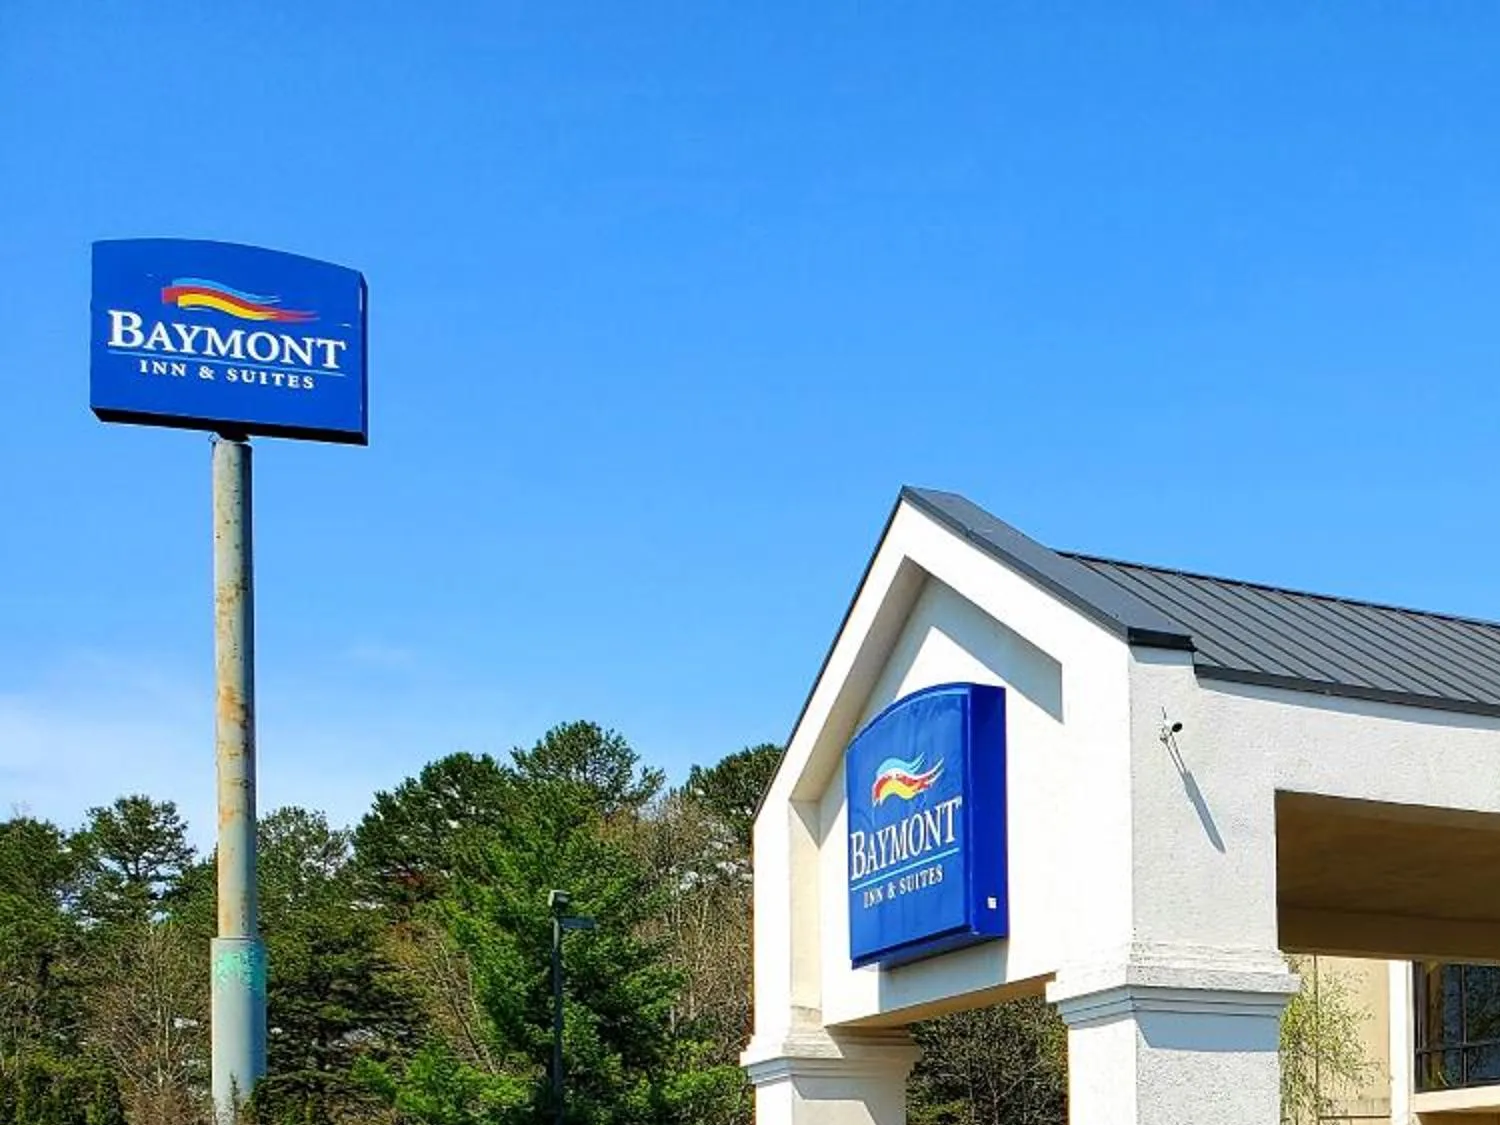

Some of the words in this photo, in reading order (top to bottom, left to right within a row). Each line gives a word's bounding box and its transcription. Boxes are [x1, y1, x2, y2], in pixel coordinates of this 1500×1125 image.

[107, 309, 347, 369] BAYMONT
[139, 359, 187, 377] INN
[199, 366, 215, 380] &
[226, 367, 315, 389] SUITES
[851, 796, 963, 880] BAYMONT
[863, 888, 883, 909] INN
[887, 882, 897, 901] &
[899, 863, 944, 895] SUITES
